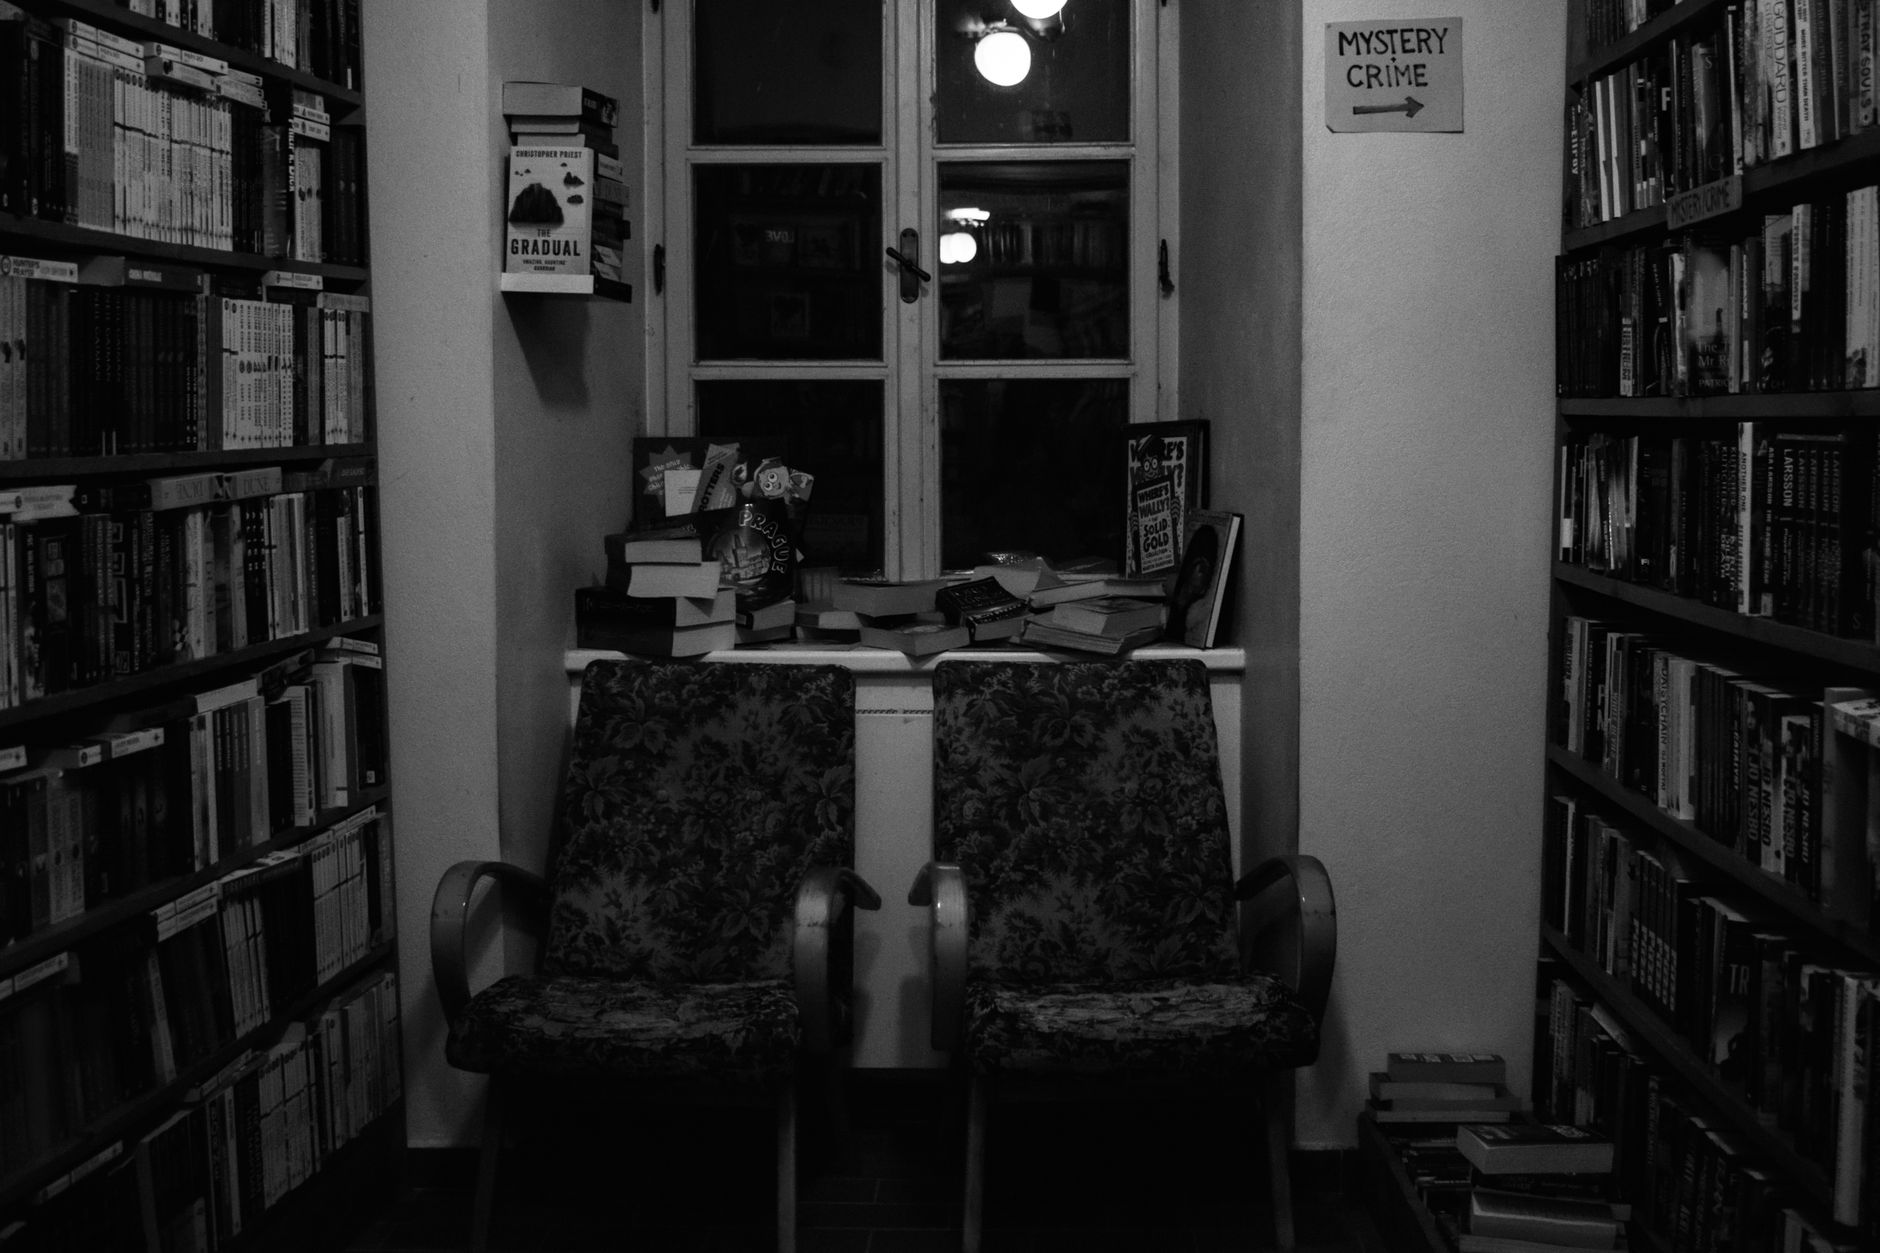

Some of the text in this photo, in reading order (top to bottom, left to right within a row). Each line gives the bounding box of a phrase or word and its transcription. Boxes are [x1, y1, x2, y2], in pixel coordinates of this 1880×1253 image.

[1338, 27, 1448, 56] MYSTERY
[1773, 1, 1788, 104] GODDARD
[1346, 62, 1429, 89] CRIME
[1860, 56, 1872, 109] SOULS
[516, 150, 582, 159] CHRISTOPHER PRIEST
[1570, 129, 1579, 175] Ellroy
[510, 239, 581, 257] GRADUAL
[536, 229, 551, 238] THE
[1138, 484, 1169, 504] WHERE'S
[1766, 467, 1774, 505] LARSSON
[1783, 448, 1793, 507] LARSSON
[1797, 449, 1805, 509] LARSSON
[1809, 449, 1817, 510] LARSSON
[1821, 449, 1829, 512] LARSSON
[1831, 449, 1840, 513] LARSSON
[1139, 496, 1171, 520] WALLY?
[1143, 518, 1168, 537] SOLID
[738, 505, 791, 574] PRAGUE
[1143, 533, 1169, 553] GOLD
[1660, 668, 1668, 746] DAISYCHAIN
[1732, 731, 1740, 791] CATALYST
[1748, 758, 1758, 841] JO NESBO
[1762, 765, 1771, 847] JO NESBO
[1801, 783, 1810, 864] JO NESBO
[1785, 808, 1796, 859] NESBO
